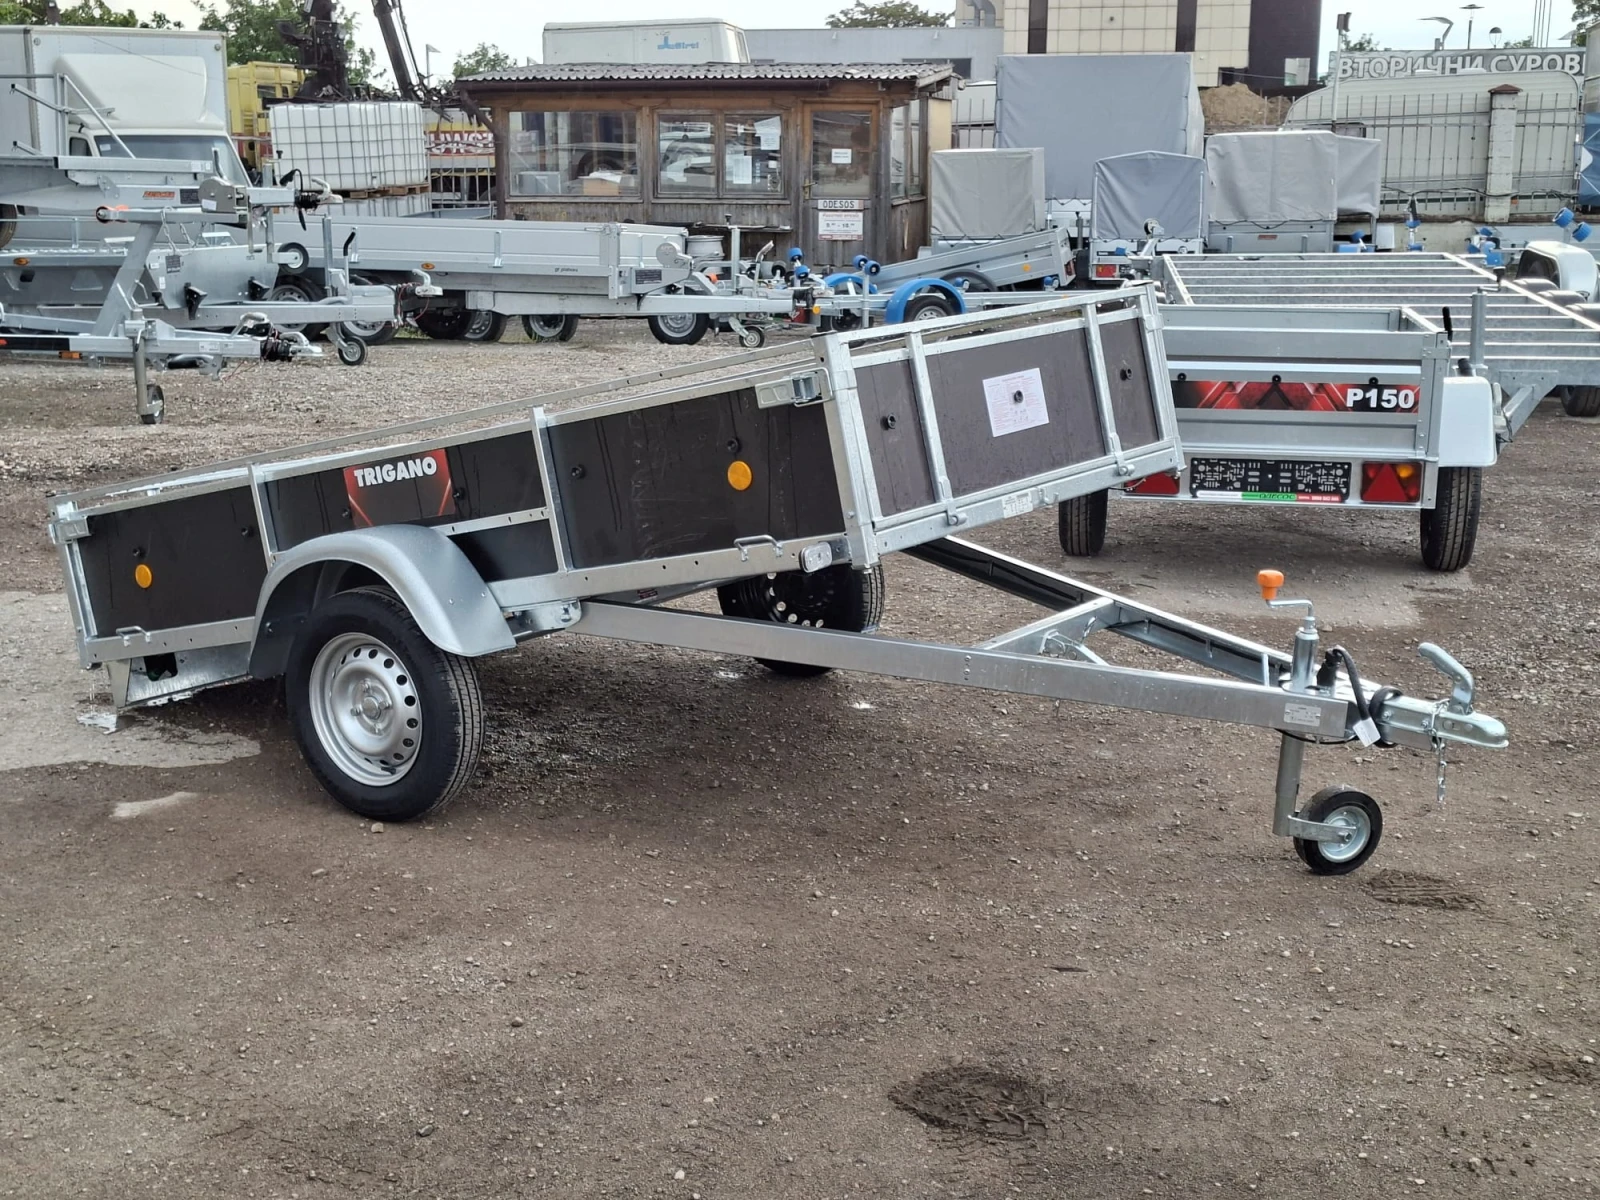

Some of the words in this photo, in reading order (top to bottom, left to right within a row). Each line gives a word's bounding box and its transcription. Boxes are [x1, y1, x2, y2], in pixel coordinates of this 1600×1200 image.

[1339, 55, 1484, 77] ВТОРИЧНИ
[822, 200, 855, 208] ODESOS
[1346, 388, 1415, 409] P150
[353, 456, 437, 488] TRIGANO
